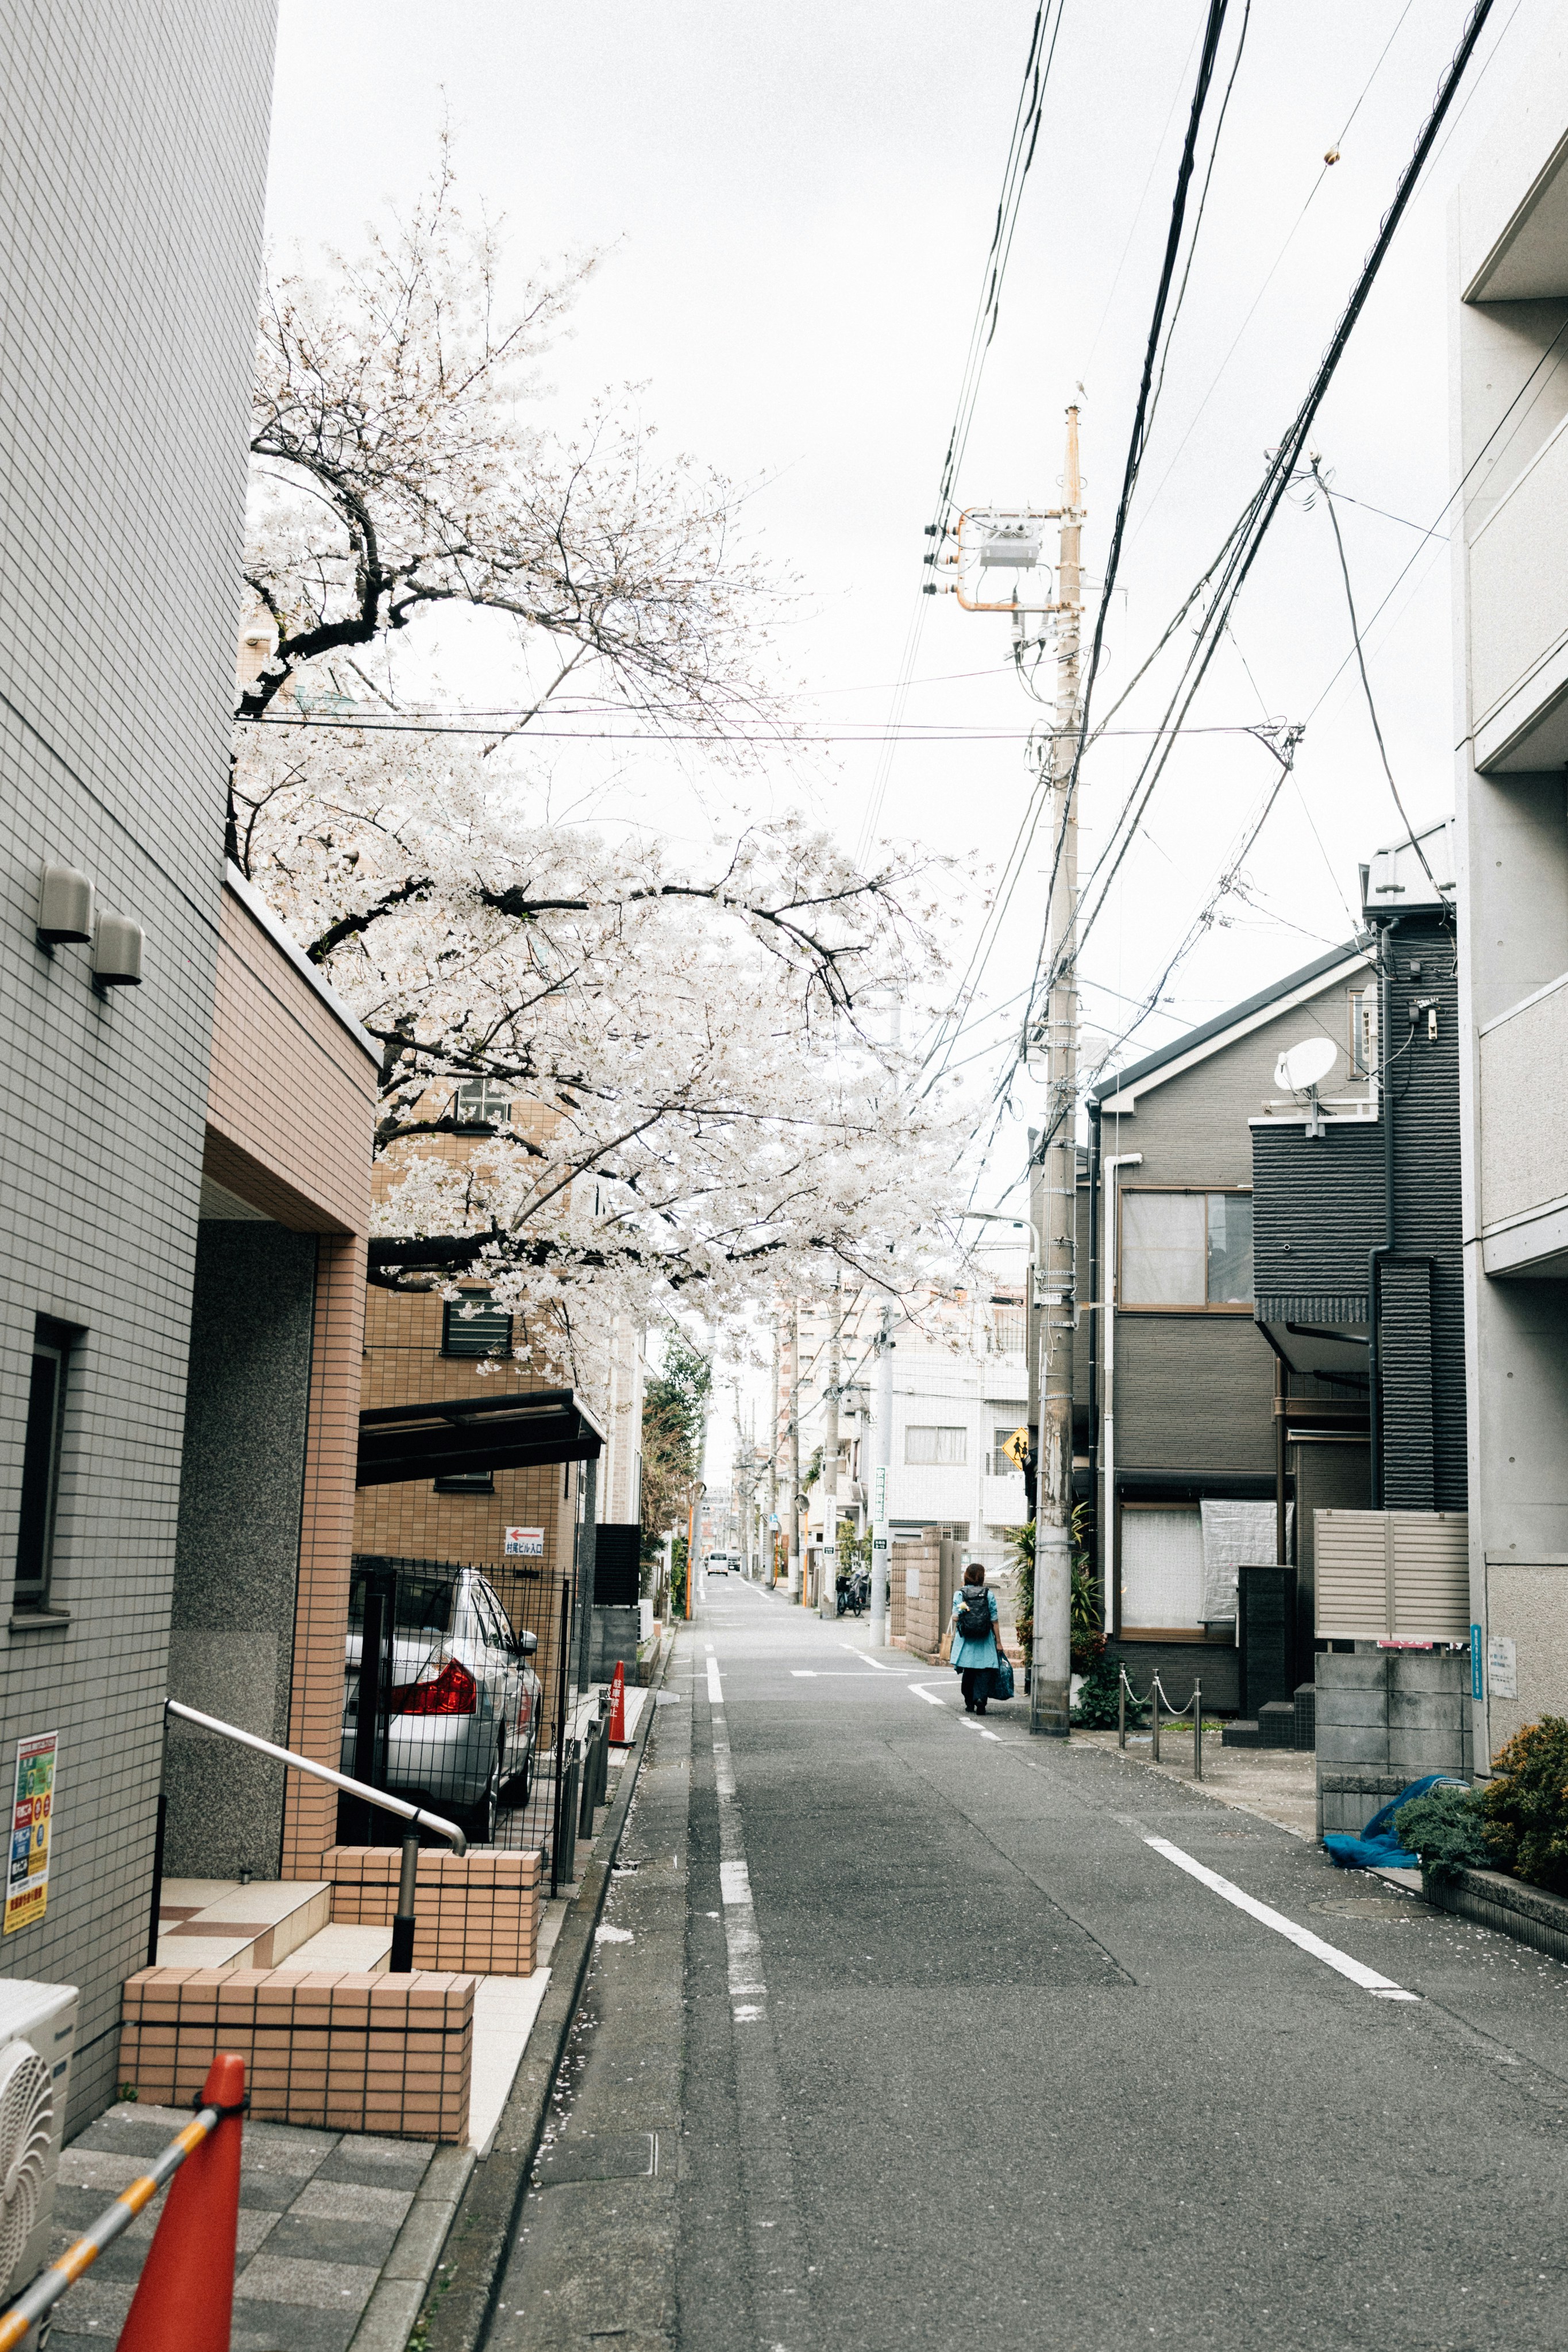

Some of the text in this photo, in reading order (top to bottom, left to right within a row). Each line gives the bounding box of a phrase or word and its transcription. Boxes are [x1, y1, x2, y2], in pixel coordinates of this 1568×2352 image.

[507, 1542, 542, 1554] 村尾ビル入口
[610, 1679, 622, 1717] 駐車禁止
